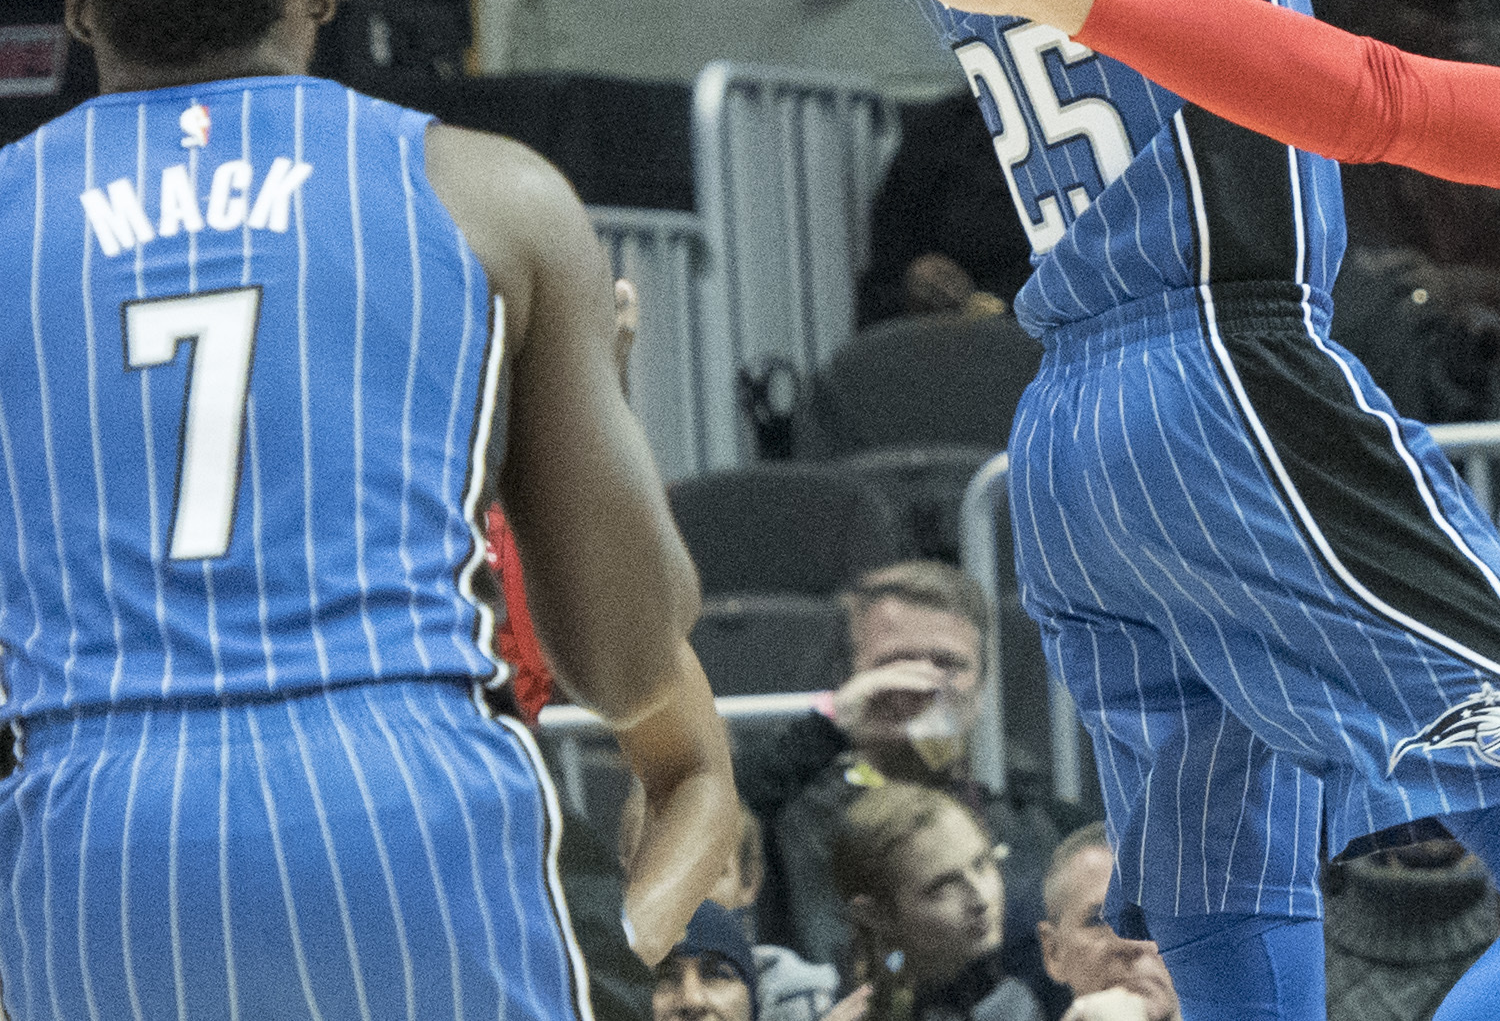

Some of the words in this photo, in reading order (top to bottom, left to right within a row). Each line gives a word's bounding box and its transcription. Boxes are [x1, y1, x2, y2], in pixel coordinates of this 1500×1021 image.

[80, 156, 313, 258] MACK
[952, 20, 1138, 256] 25
[120, 284, 263, 562] 7
